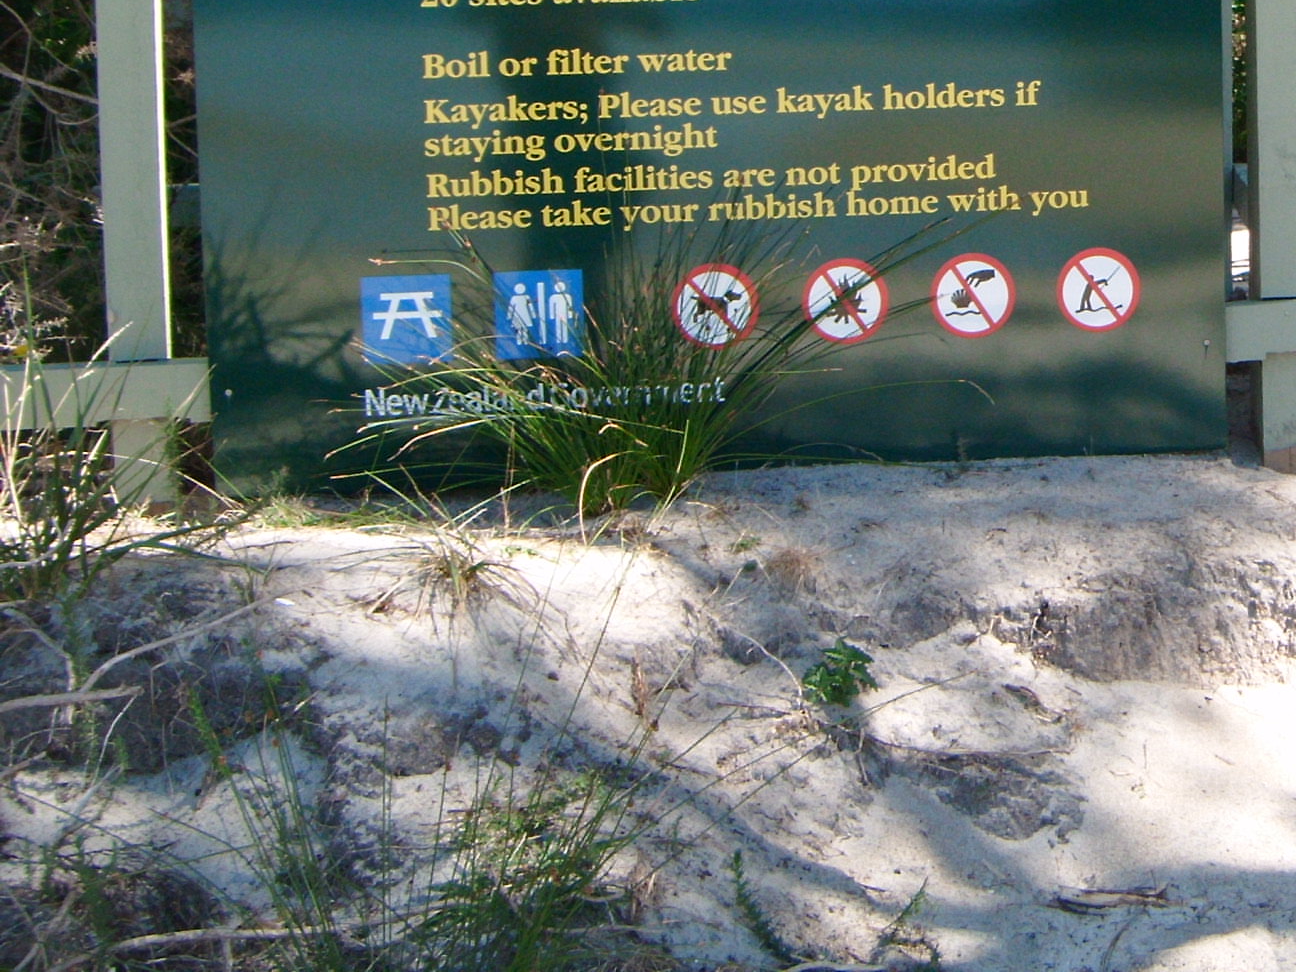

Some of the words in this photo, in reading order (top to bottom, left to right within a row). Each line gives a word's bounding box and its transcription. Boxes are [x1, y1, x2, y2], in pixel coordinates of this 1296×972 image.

[421, 50, 491, 79] Boil
[498, 57, 538, 77] or
[546, 47, 630, 76] filter
[636, 49, 733, 73] water
[423, 94, 588, 131] Kayakers;
[598, 91, 702, 119] Please
[710, 95, 767, 116] use
[775, 84, 875, 120] kayak
[882, 81, 1006, 111] holders
[1015, 80, 1042, 107] if
[424, 129, 546, 163] staying
[554, 122, 719, 157] overnight
[425, 167, 566, 198] Rubbish
[574, 164, 714, 193] facilities
[723, 168, 776, 188] are
[785, 162, 841, 187] not
[849, 154, 997, 189] provided
[427, 203, 532, 232] Please
[540, 199, 611, 227] take
[619, 203, 700, 232] your
[707, 191, 837, 222] rubbish
[846, 188, 940, 216] home
[946, 184, 1023, 213] with
[1029, 188, 1090, 216] you
[365, 388, 428, 417] New
